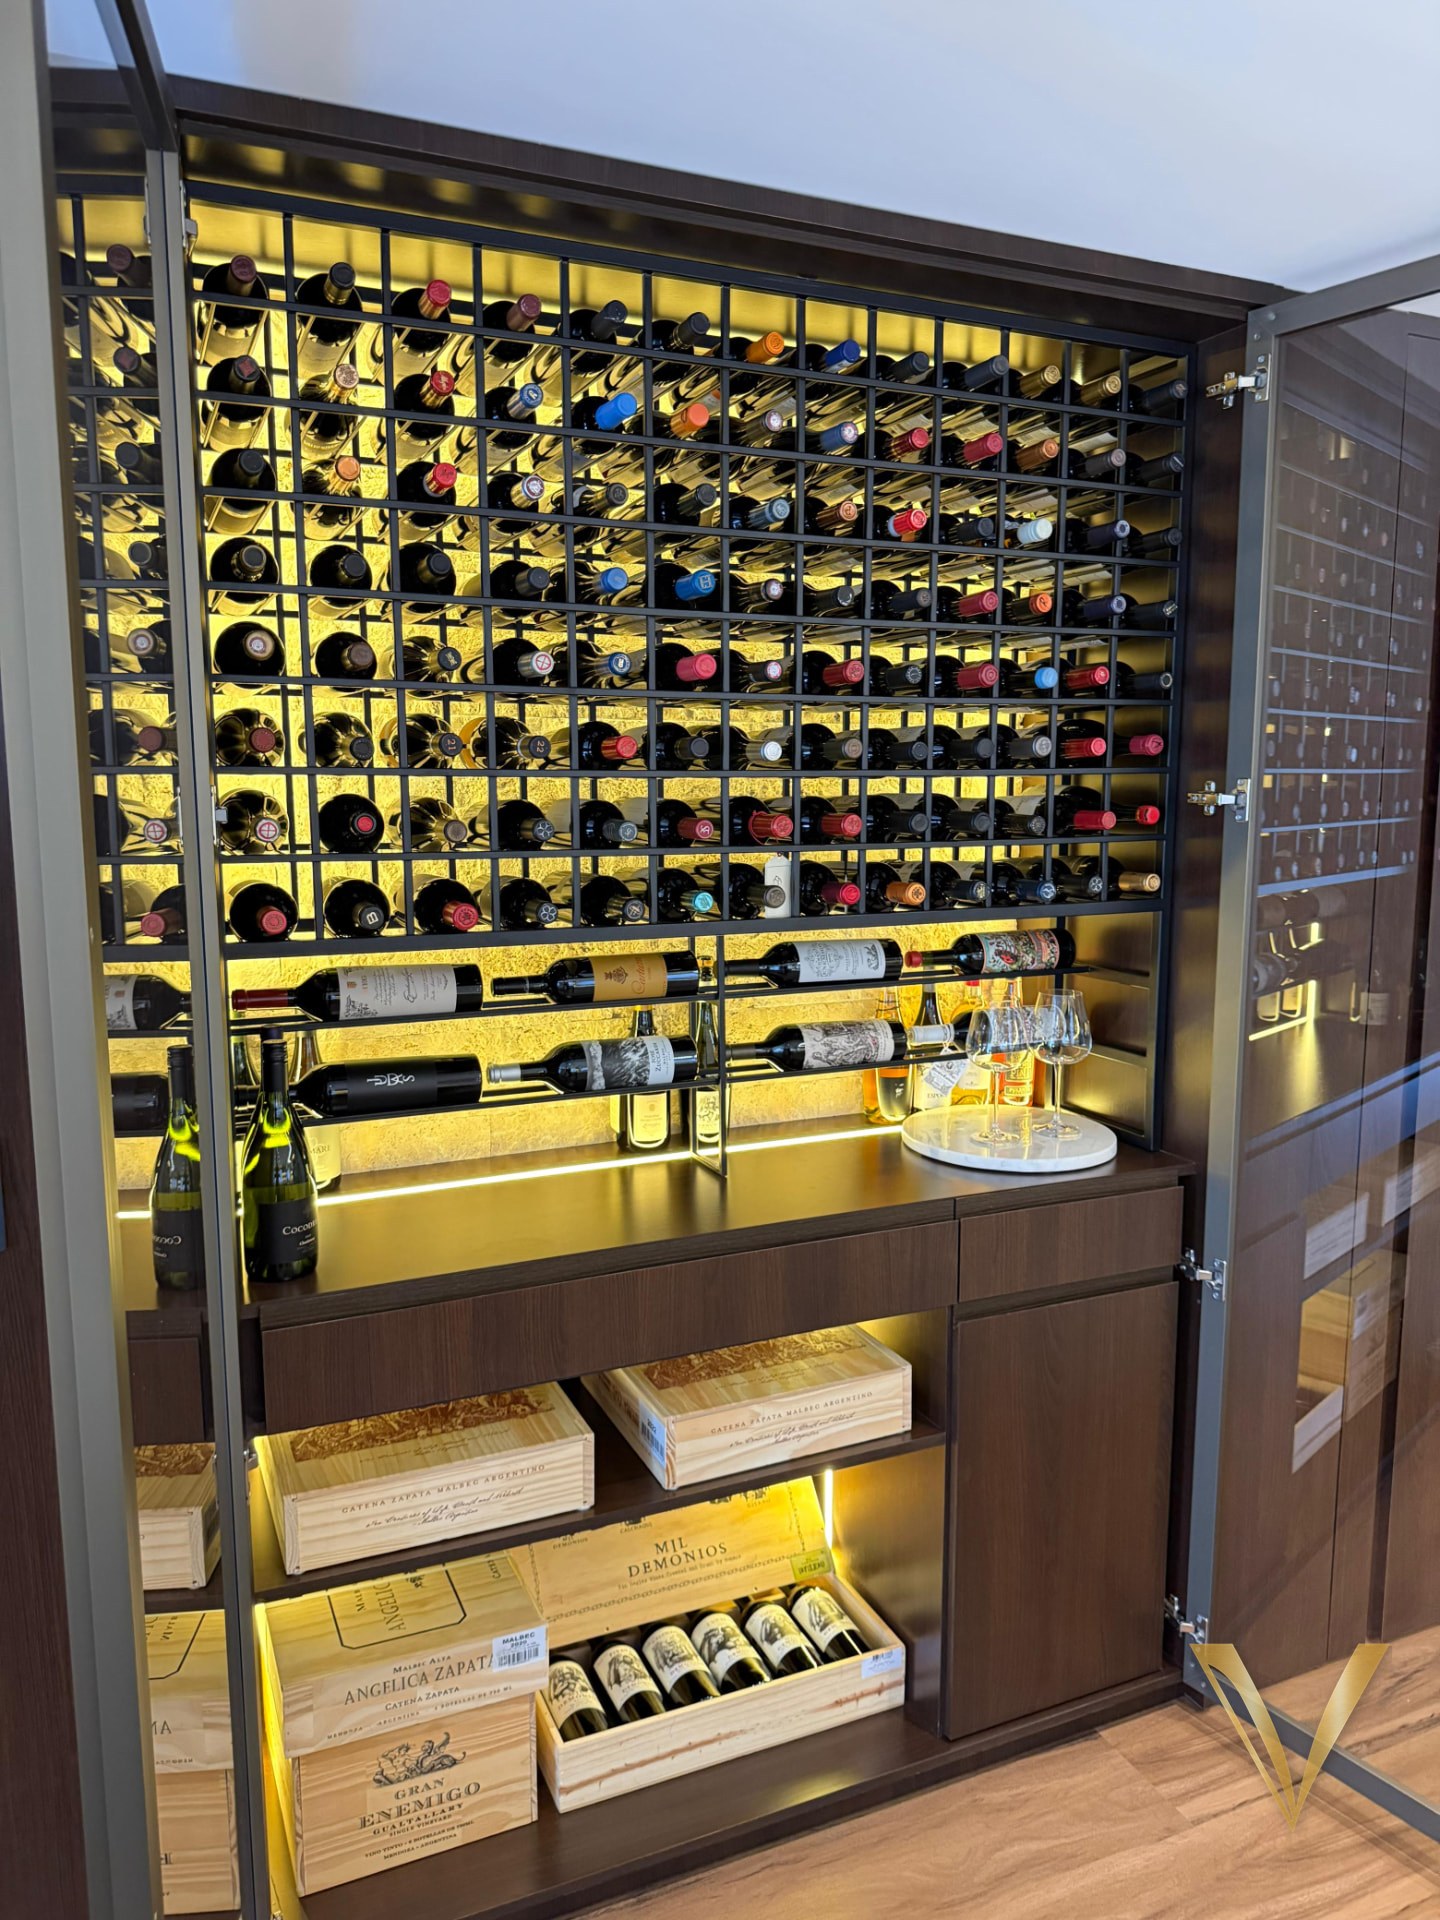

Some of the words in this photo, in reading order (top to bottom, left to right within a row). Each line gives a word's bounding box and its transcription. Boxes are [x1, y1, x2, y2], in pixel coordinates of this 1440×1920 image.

[711, 1422, 746, 1434] CATENA
[750, 1413, 782, 1424] ZAPATA
[786, 1404, 820, 1416] MALBEC
[823, 1391, 873, 1408] ARGENTINO
[342, 1500, 386, 1514] CATENA
[391, 1490, 432, 1504] ZAPATA
[437, 1479, 480, 1494] MALBEC
[484, 1464, 546, 1484] ARGENTINO
[627, 1542, 728, 1578] DEMONIOS
[654, 1536, 689, 1556] MIL
[372, 1582, 407, 1632] ANGELIC
[502, 1632, 536, 1644] MALBEC
[344, 1671, 429, 1705] ANGELICA
[394, 1777, 445, 1800] GRAN
[359, 1782, 481, 1830] ENEMIGO
[372, 1802, 464, 1836] GUALTALLARY
[416, 1814, 452, 1829] VINEYARD
